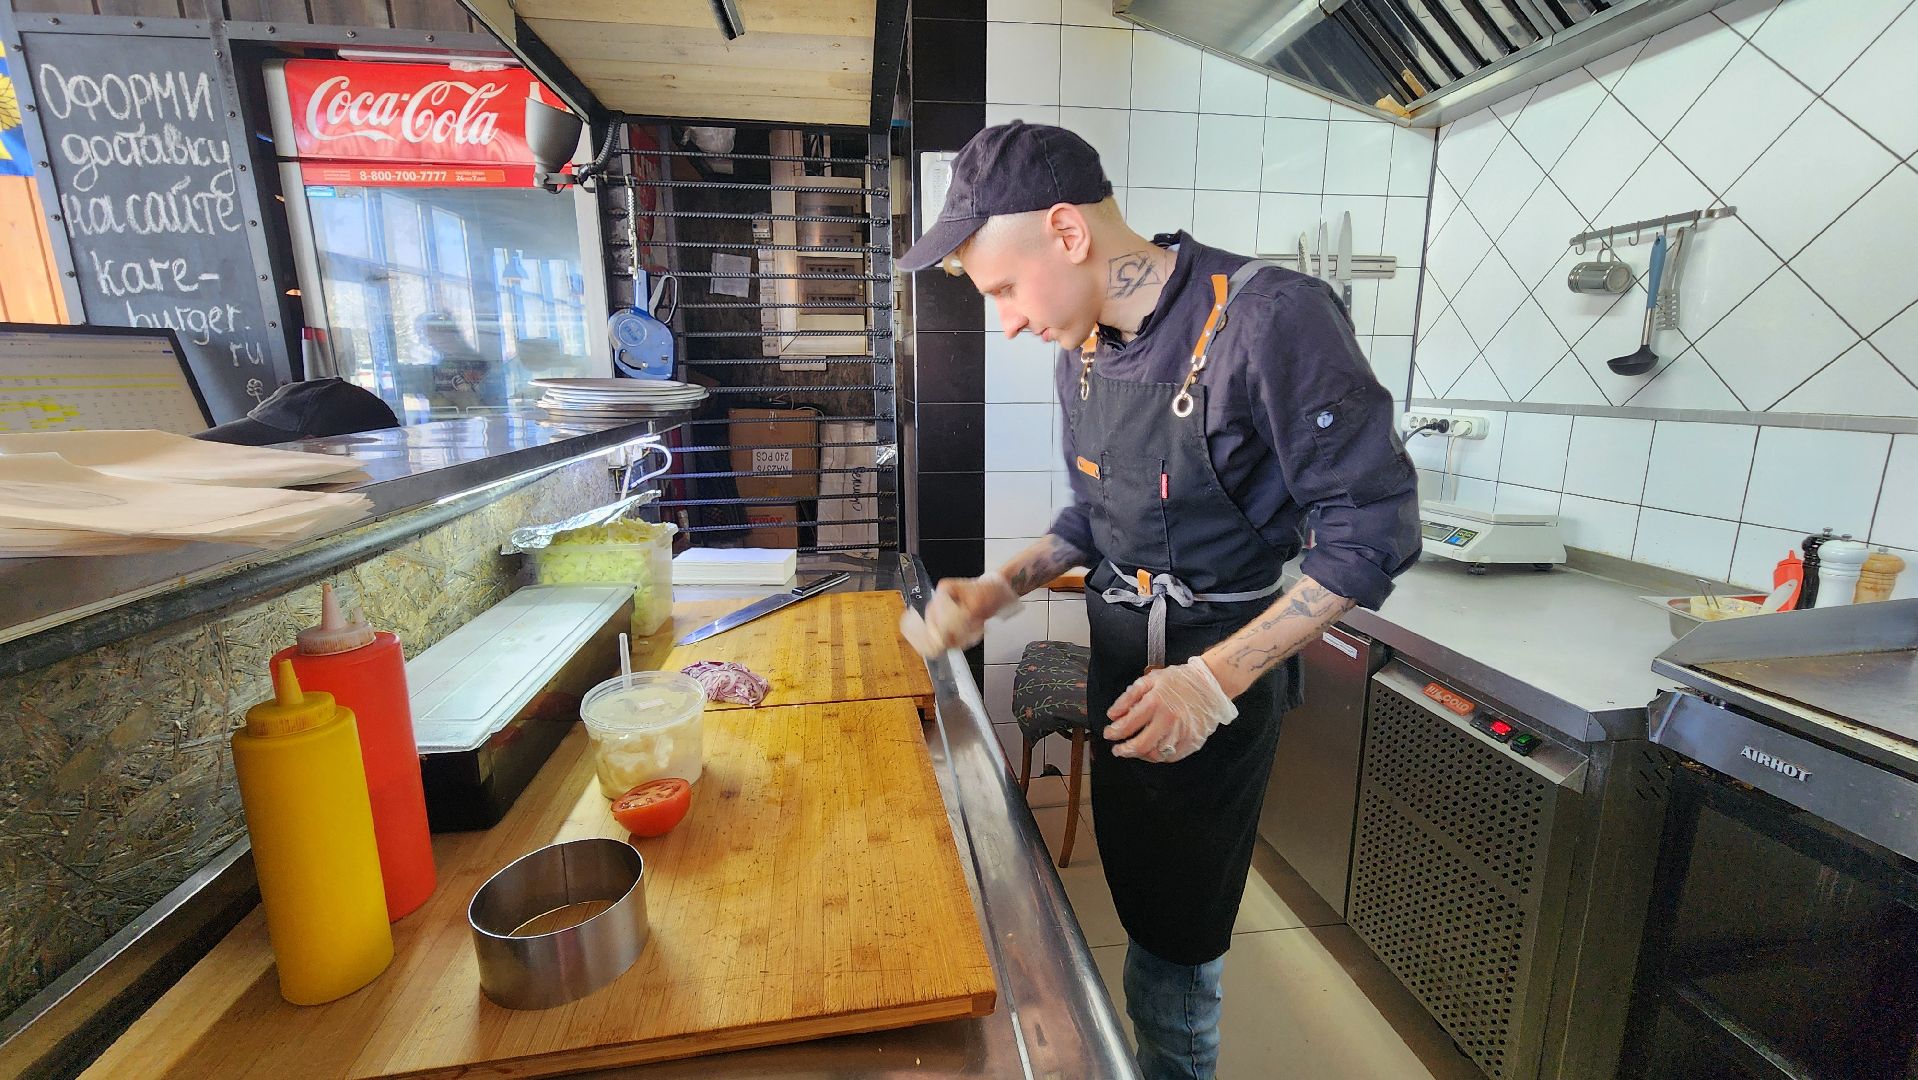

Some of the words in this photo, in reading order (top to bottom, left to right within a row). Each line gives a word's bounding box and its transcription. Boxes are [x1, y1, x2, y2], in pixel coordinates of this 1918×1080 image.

[305, 75, 509, 146] Coca-Cola
[60, 121, 236, 197] доставку
[359, 170, 447, 182] 8-800-700-7777
[60, 192, 126, 238] на
[125, 175, 241, 236] сайте
[756, 451, 773, 462] PCS
[775, 451, 790, 462] 240
[1740, 745, 1813, 782] AIRHOT
